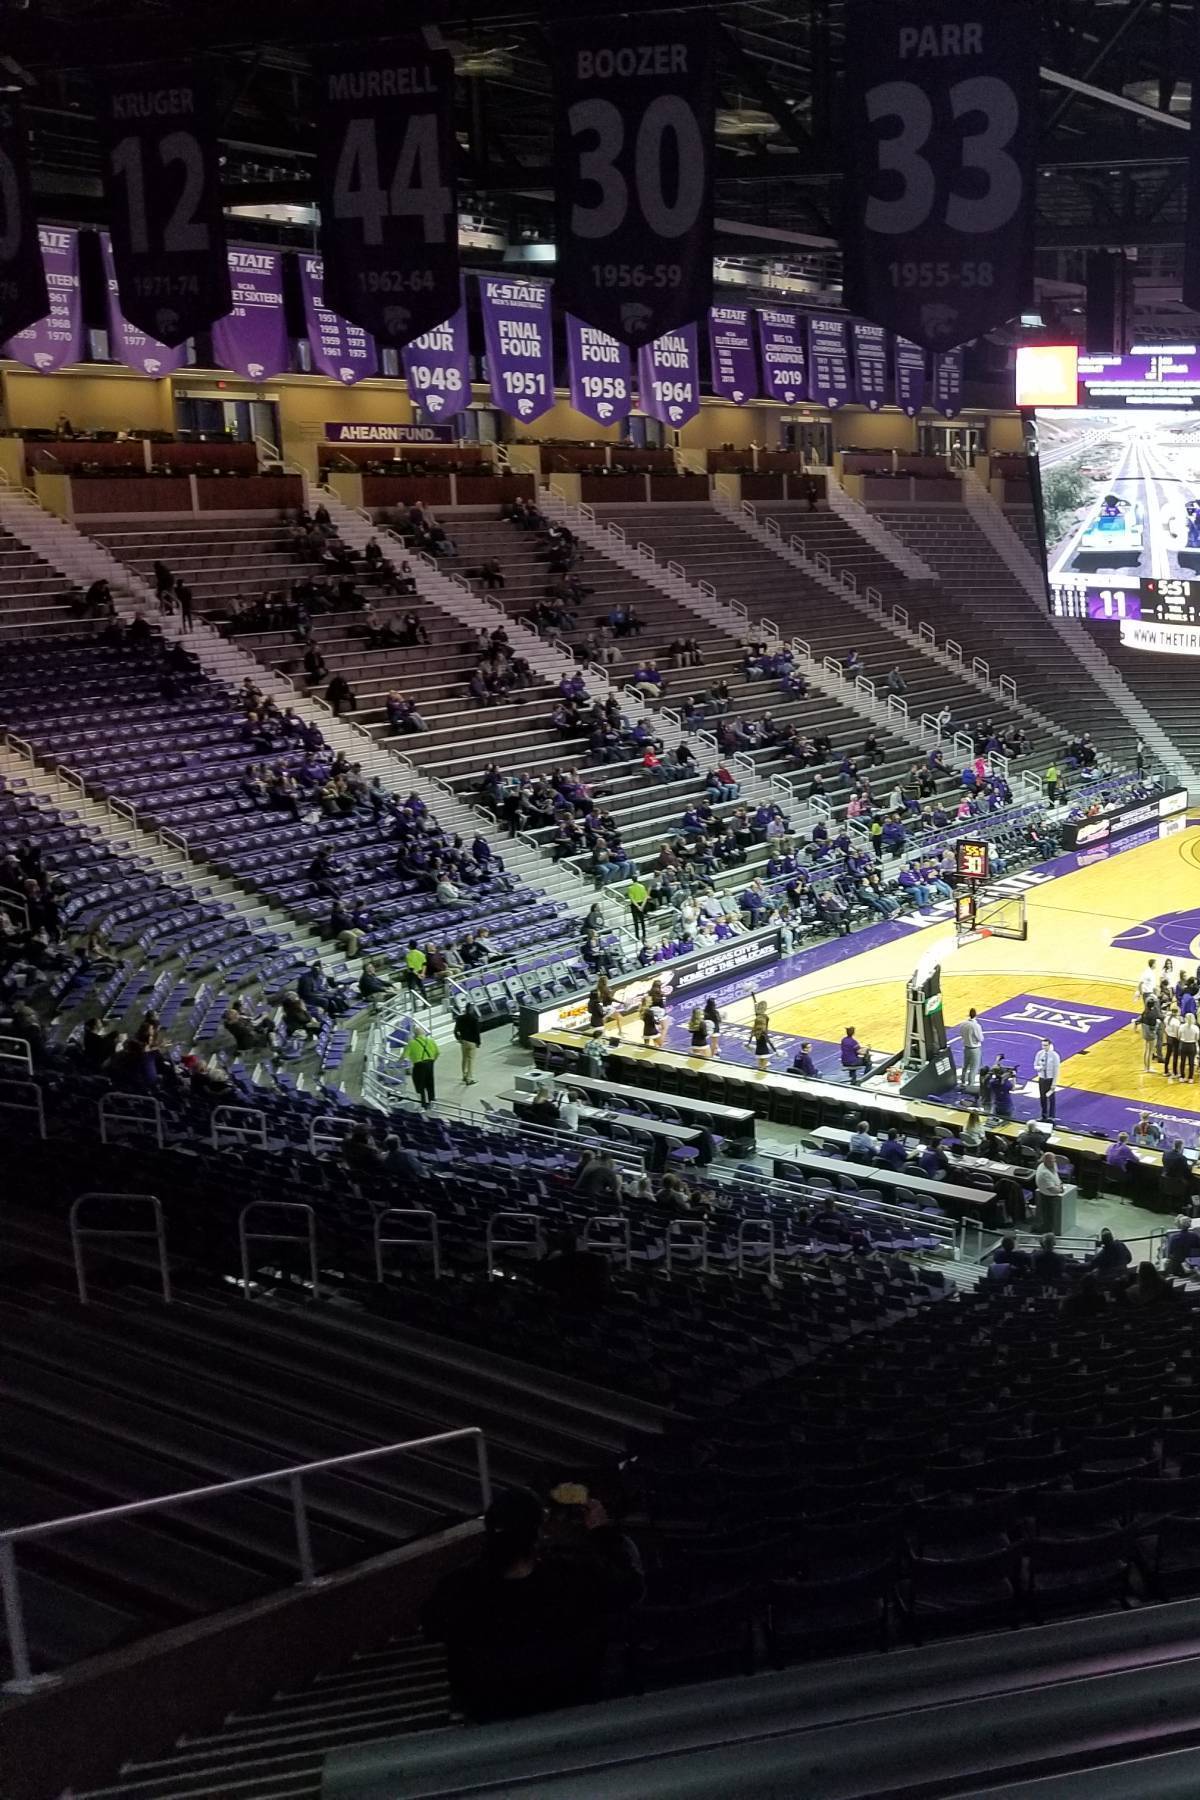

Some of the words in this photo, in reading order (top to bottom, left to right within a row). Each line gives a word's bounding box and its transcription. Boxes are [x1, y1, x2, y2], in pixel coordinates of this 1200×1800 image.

[900, 22, 983, 58] PARR
[578, 43, 688, 80] BOOZER
[328, 64, 438, 102] MURRELL
[113, 88, 194, 118] KRUGER
[864, 76, 1022, 234] 33
[568, 94, 705, 239] 30
[334, 113, 454, 244] 44
[112, 131, 210, 253] 12
[359, 270, 436, 292] 1962-64
[592, 264, 681, 288] 1956-59
[888, 262, 993, 288] 1955-58
[48, 293, 67, 303] 961
[487, 283, 546, 303] K-STATE
[50, 306, 69, 316] 964
[711, 307, 748, 321] K-STATE
[762, 311, 797, 325] K-STATE
[498, 320, 541, 340] FINAL
[580, 327, 620, 347] FINAL
[500, 339, 541, 358] FOUR
[582, 344, 620, 363] FOUR
[653, 336, 689, 353] FINAL
[654, 351, 690, 369] FOUR
[411, 366, 462, 391] 1948
[503, 372, 546, 395] 1951
[581, 377, 626, 399] 1958
[773, 370, 802, 385] 2019
[652, 381, 692, 402] 1964
[1158, 580, 1191, 596] 5:51
[1100, 590, 1126, 617] 11
[680, 969, 705, 985] HOME
[705, 964, 718, 976] OF
[719, 958, 735, 971] THE
[734, 944, 775, 965] WILDCATS
[697, 950, 733, 970] KANSAS
